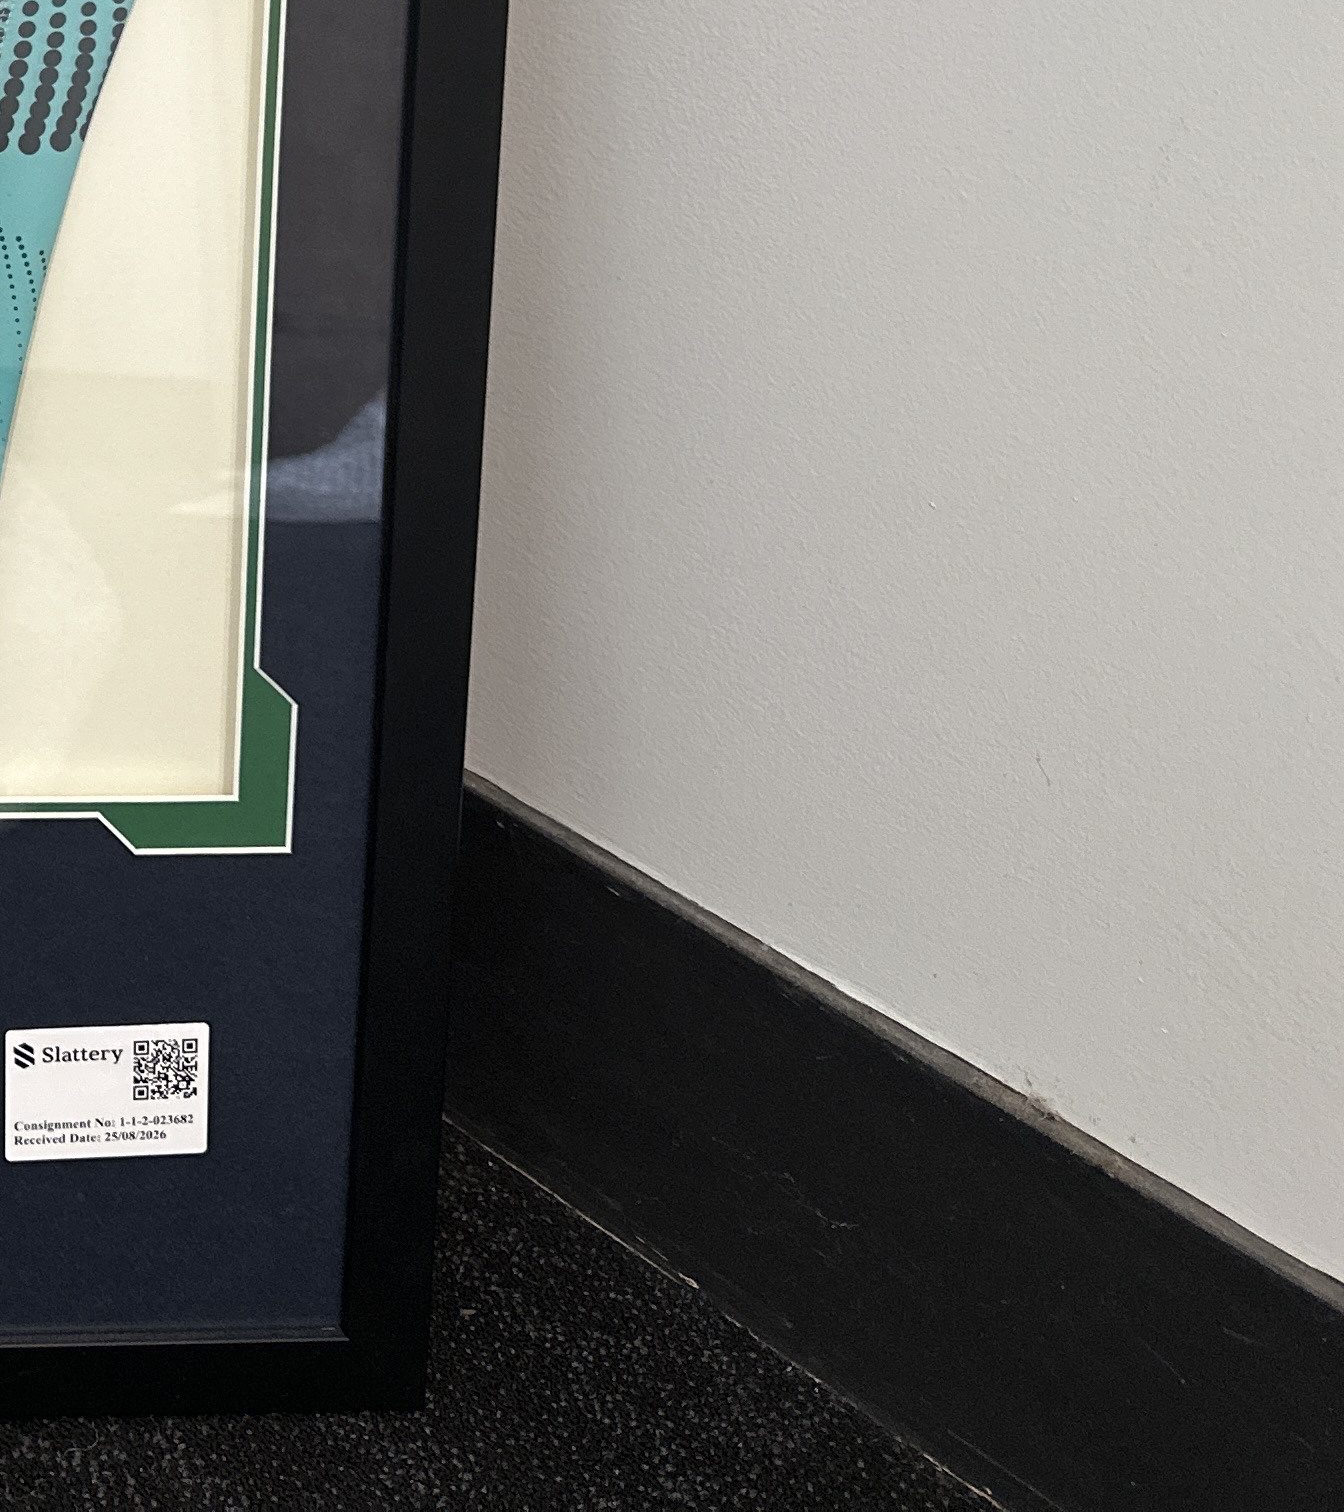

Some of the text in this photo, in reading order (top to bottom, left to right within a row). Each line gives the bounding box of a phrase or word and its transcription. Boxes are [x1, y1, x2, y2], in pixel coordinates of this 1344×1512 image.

[41, 1046, 123, 1064] Slattery
[14, 1113, 194, 1132] Consignment No: 1-1-2-023682
[14, 1130, 167, 1146] Received Date: 25/08/2026
